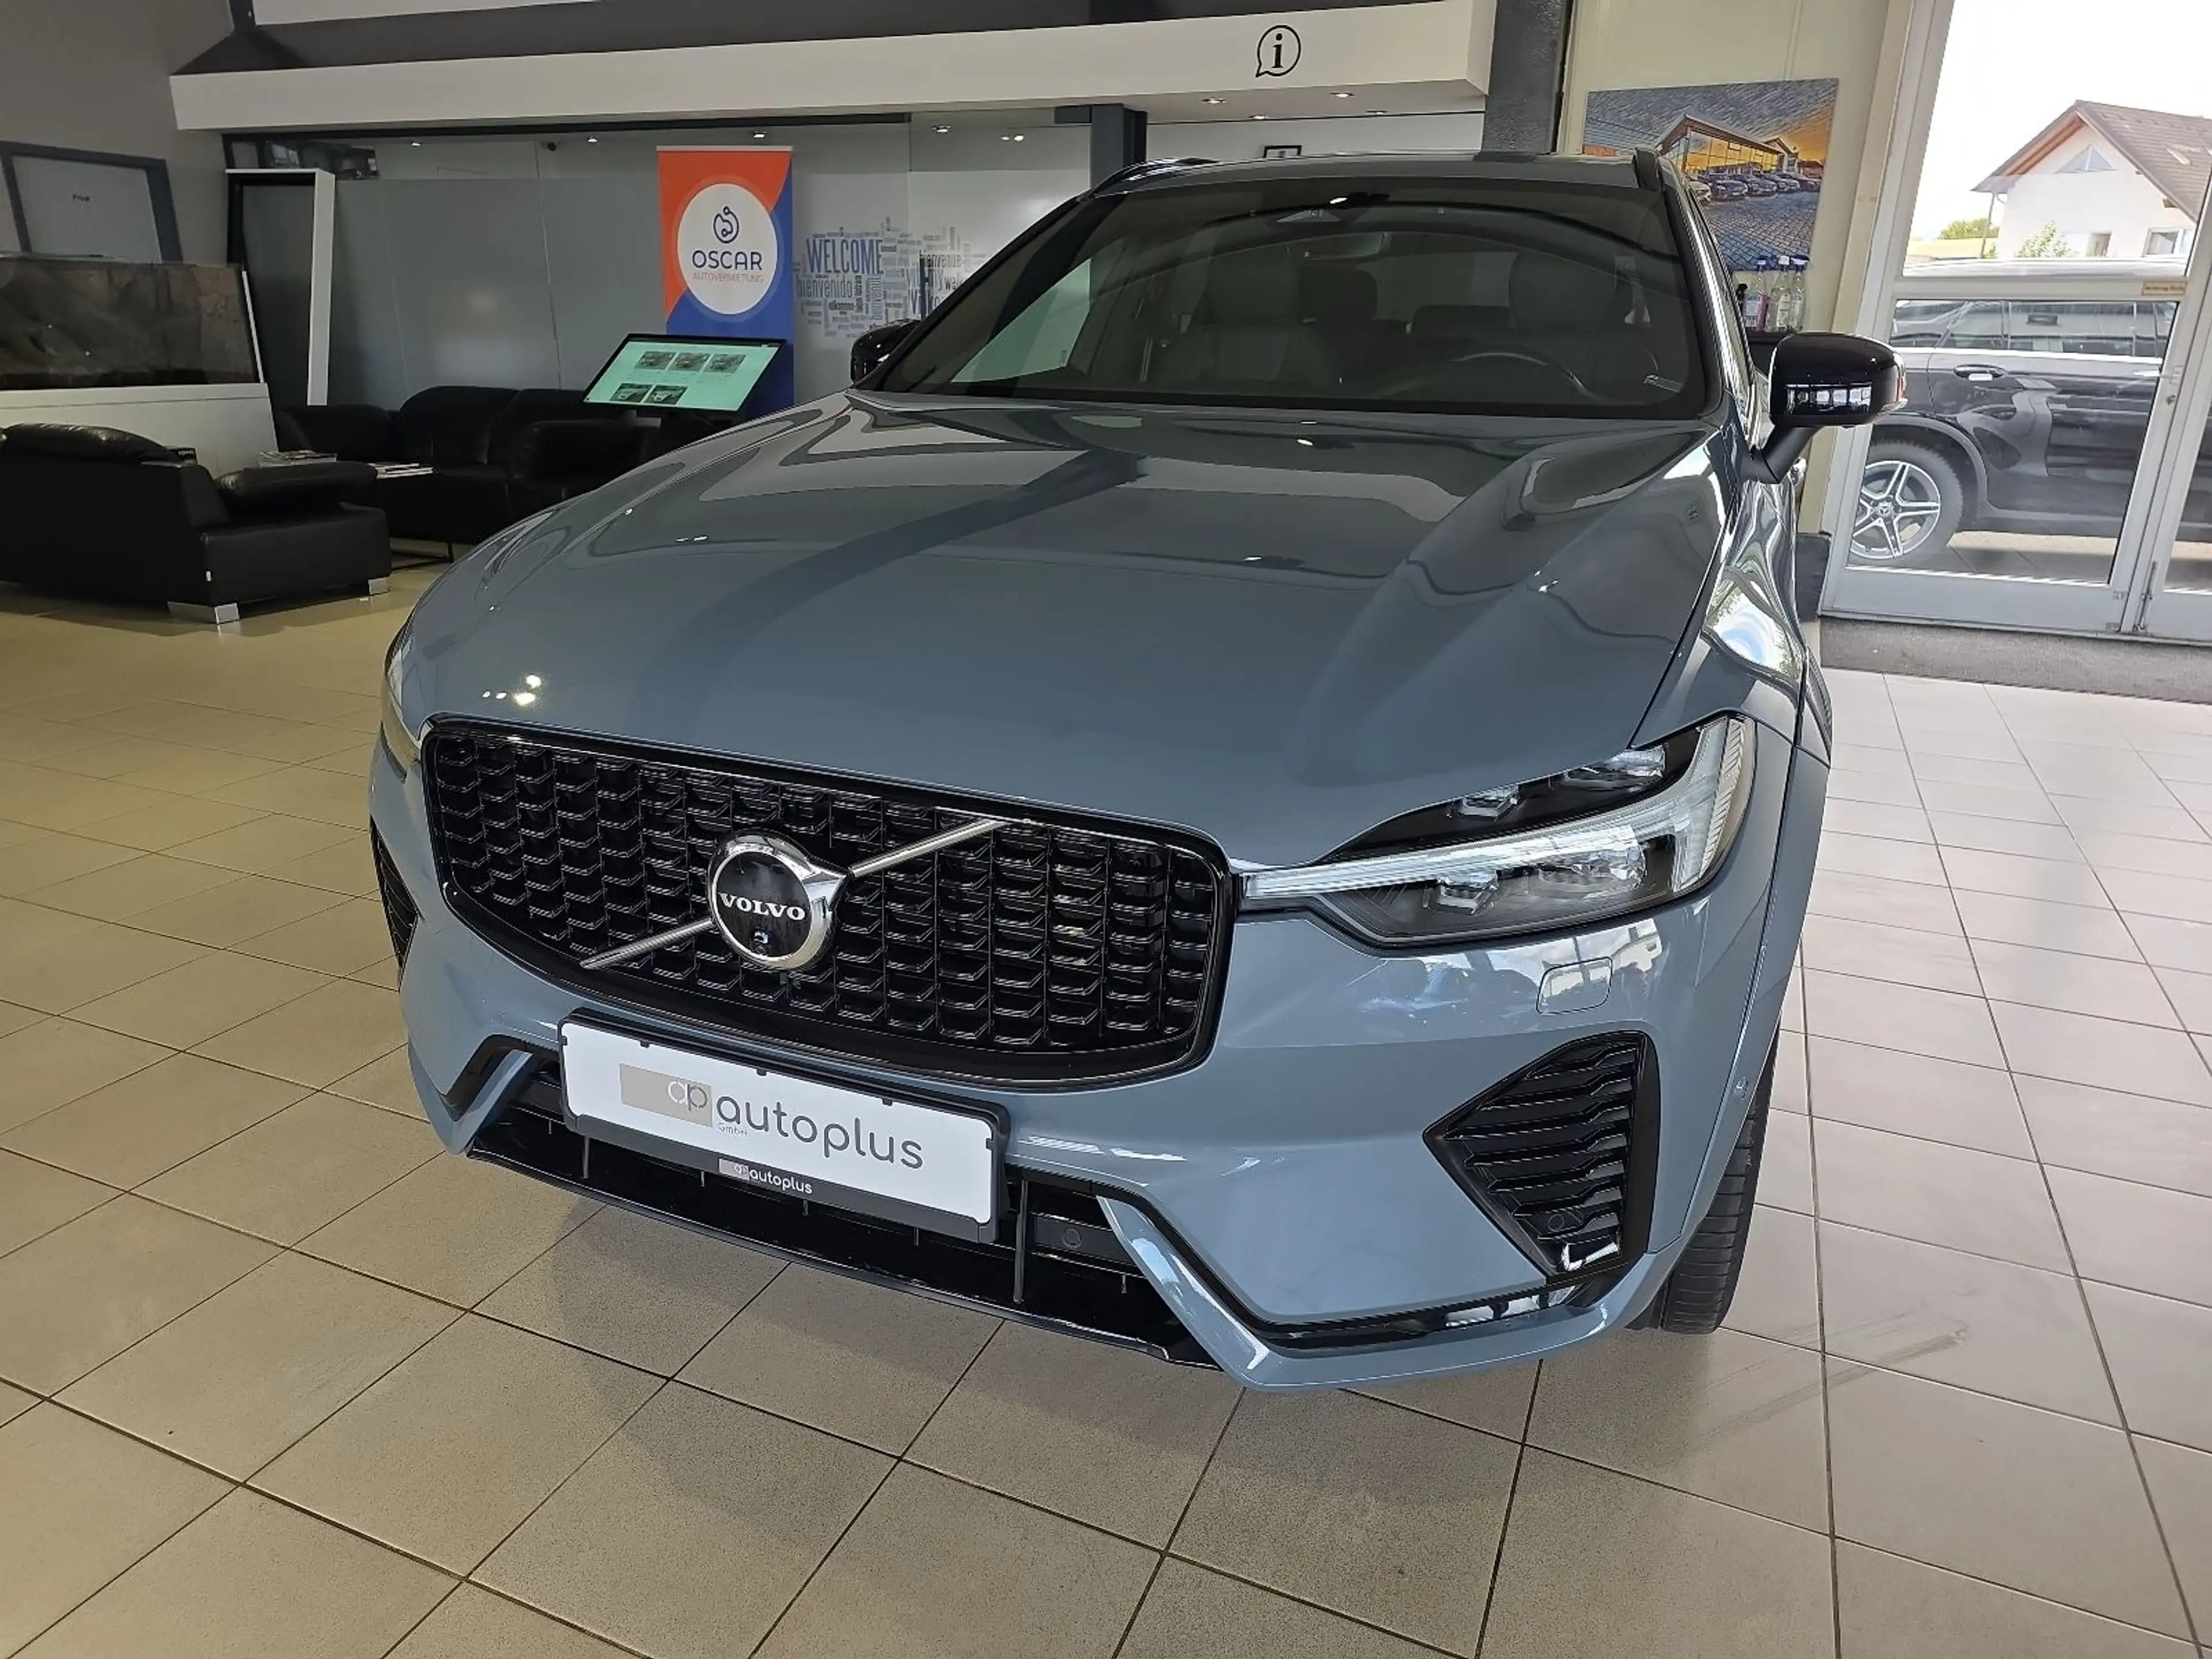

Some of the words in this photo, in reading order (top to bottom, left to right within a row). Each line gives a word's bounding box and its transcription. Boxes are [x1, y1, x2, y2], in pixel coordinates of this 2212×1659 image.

[692, 250, 763, 270] OSCAR
[806, 239, 884, 274] WELCOME
[797, 274, 853, 298] bienvenido
[718, 892, 805, 920] VOLVO
[717, 1096, 923, 1169] autoplus
[749, 1169, 812, 1194] autoplus
